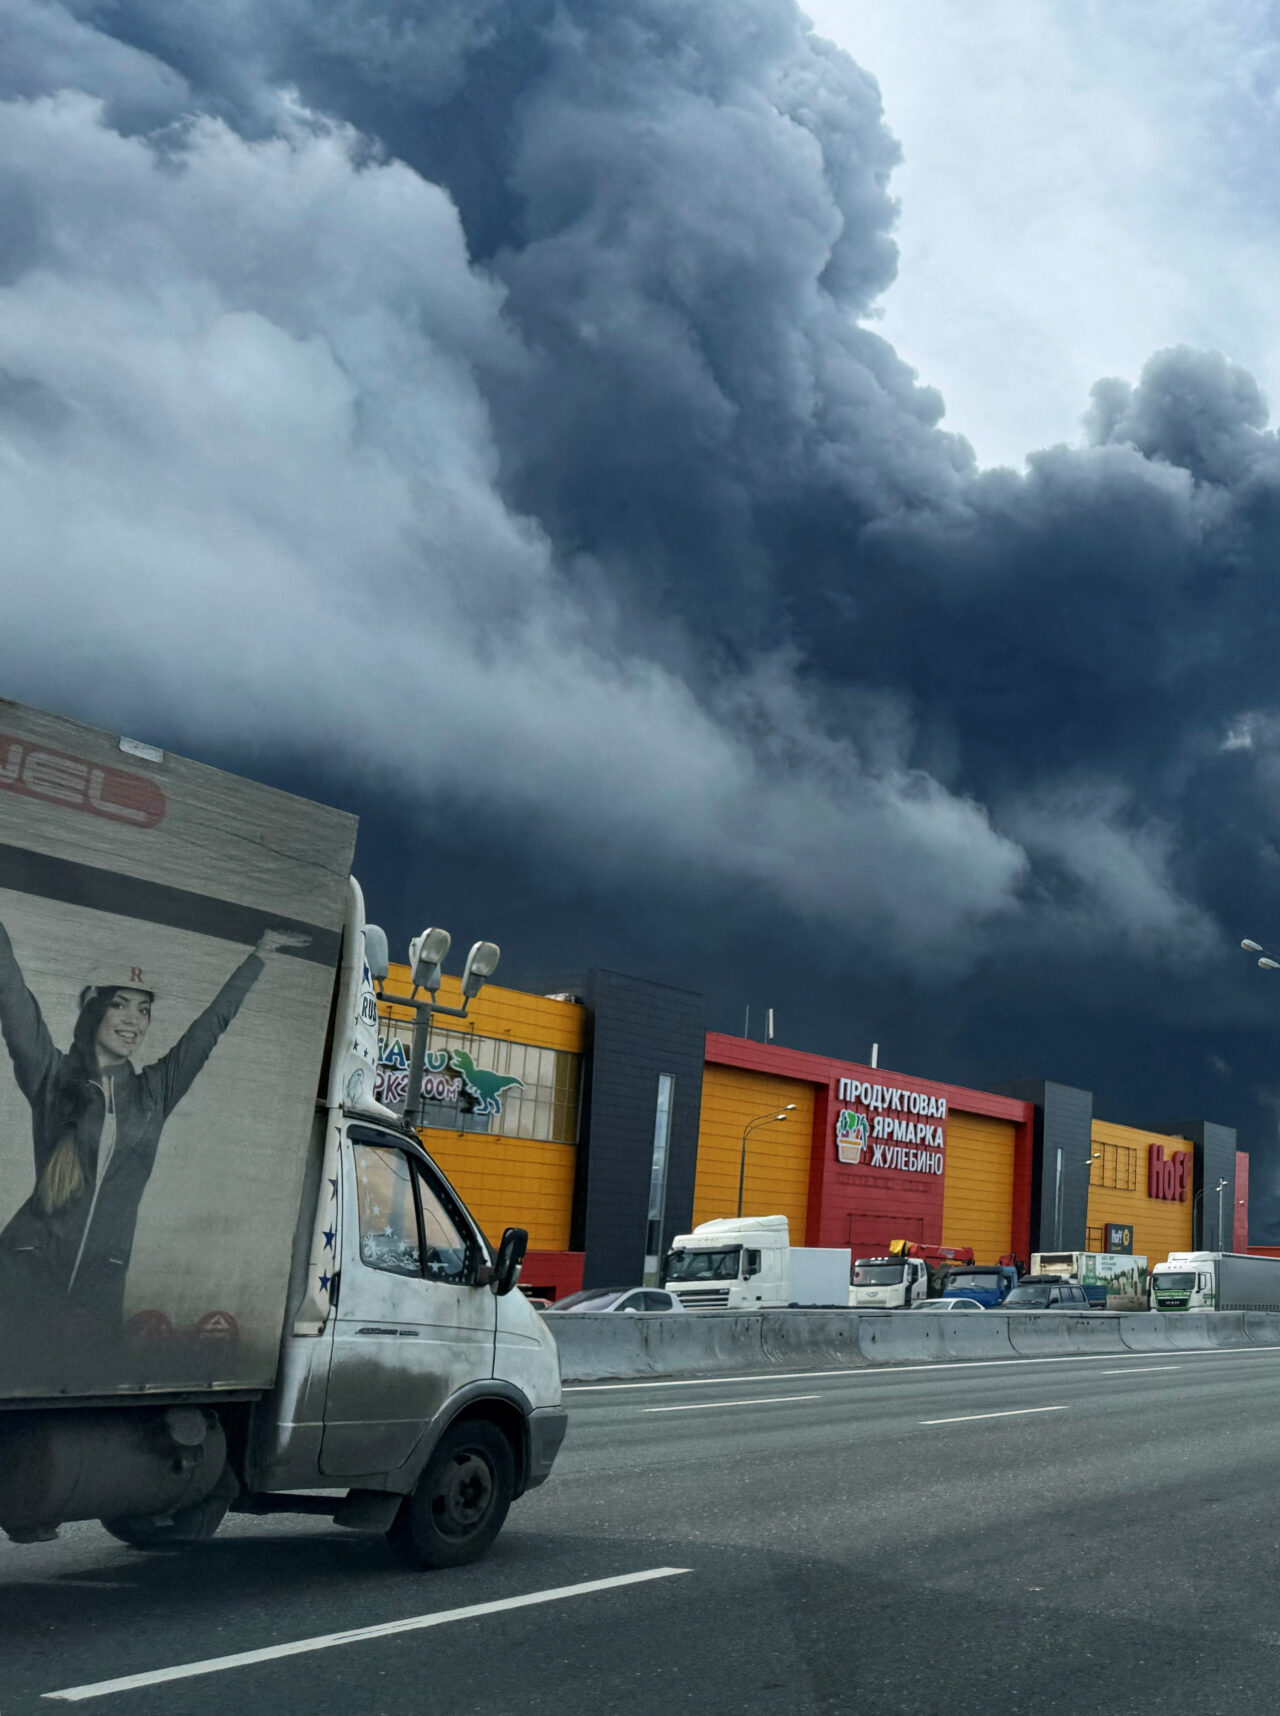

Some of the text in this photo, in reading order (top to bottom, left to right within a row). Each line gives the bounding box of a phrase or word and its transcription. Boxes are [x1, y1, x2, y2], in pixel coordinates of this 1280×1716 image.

[130, 966, 144, 984] R
[361, 996, 377, 1022] RUS
[838, 1077, 947, 1119] ПРОДУКТОВАЯ
[872, 1116, 944, 1148] ЯРМАРКА
[871, 1143, 944, 1175] ЖУЛЕБИНО
